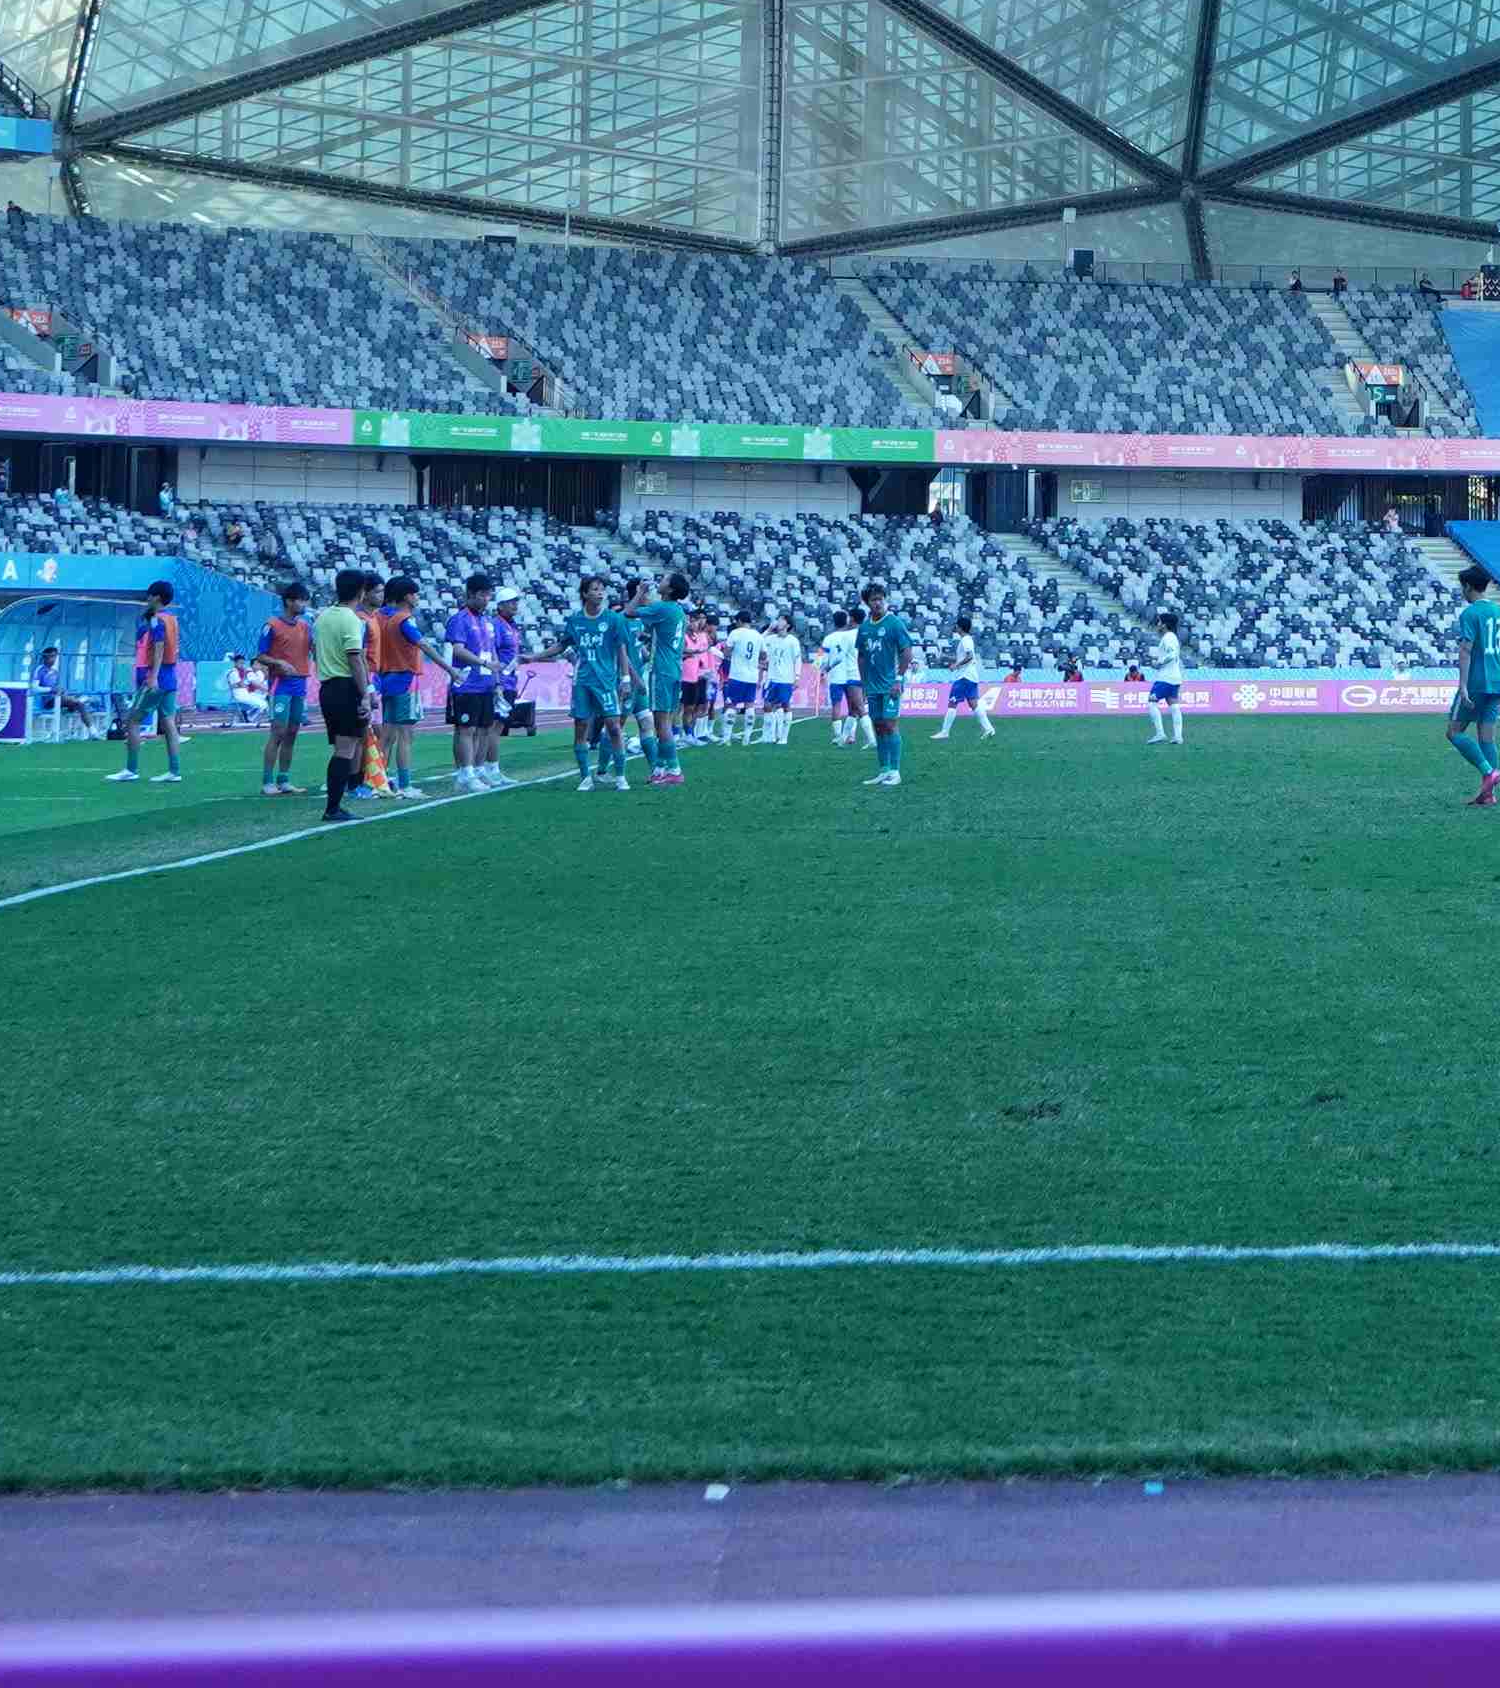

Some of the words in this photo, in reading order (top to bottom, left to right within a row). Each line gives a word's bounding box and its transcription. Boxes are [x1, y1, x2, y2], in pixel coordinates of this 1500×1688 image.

[2, 559, 19, 581] A
[746, 640, 754, 660] 9
[1124, 691, 1211, 704] 中国电网
